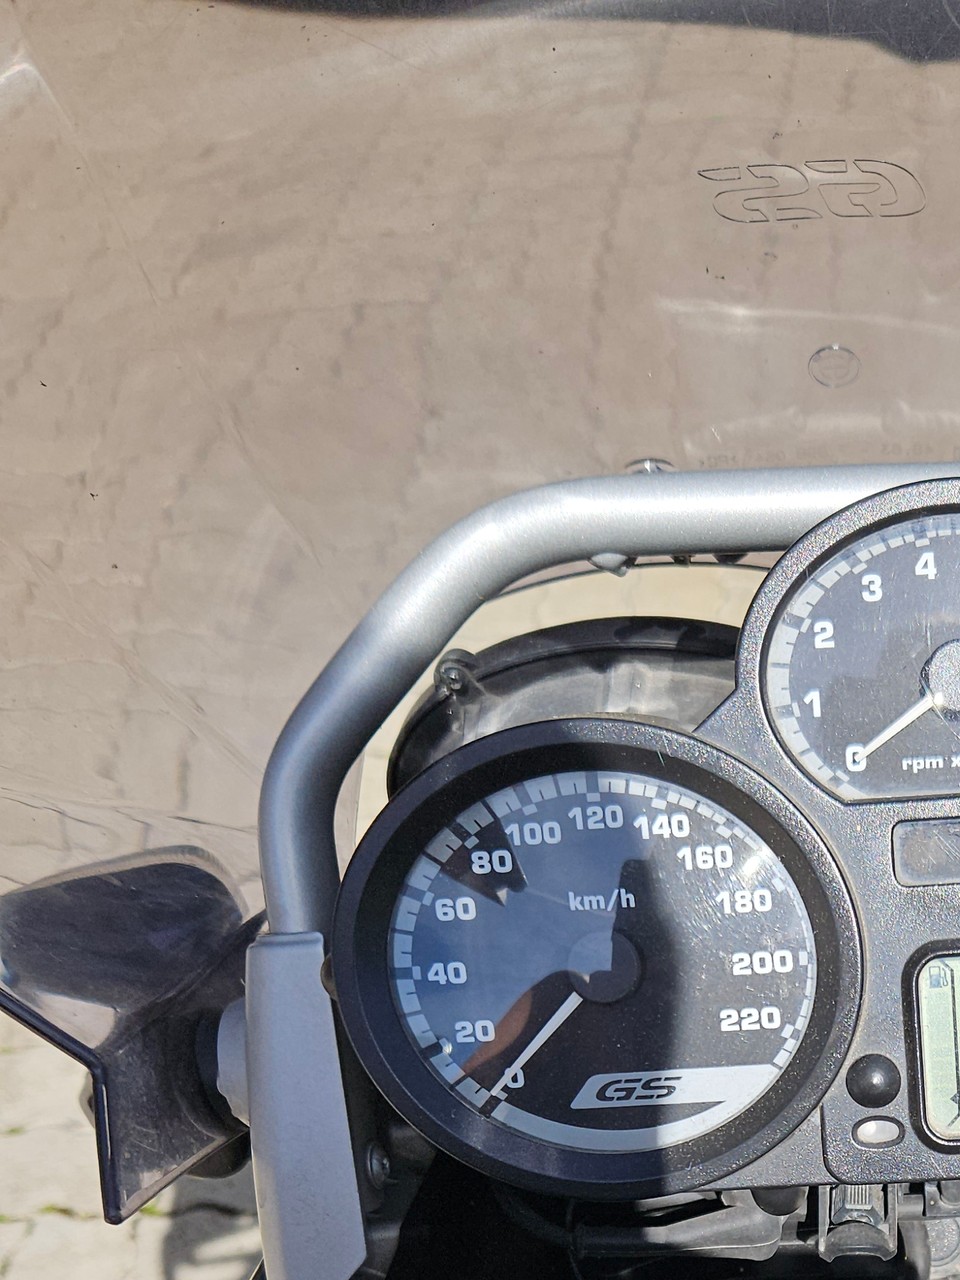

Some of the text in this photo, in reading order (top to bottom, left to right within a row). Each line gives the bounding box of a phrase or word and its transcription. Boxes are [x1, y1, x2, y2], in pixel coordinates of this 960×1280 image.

[914, 552, 937, 580] 4
[861, 574, 883, 602] 3
[813, 621, 835, 649] 2
[803, 691, 821, 718] 1
[845, 744, 867, 771] 0
[901, 756, 944, 772] rpm
[567, 804, 624, 830] 120
[633, 812, 690, 840] 140
[505, 820, 562, 846] 100
[470, 849, 513, 875] 80
[677, 844, 734, 871] 160
[434, 896, 477, 921] 60
[568, 888, 636, 911] km/h
[715, 889, 773, 915] 180
[427, 961, 468, 985] 40
[731, 949, 794, 976] 200
[455, 1019, 496, 1044] 20
[719, 1006, 781, 1032] 220
[595, 1076, 683, 1101] GS
